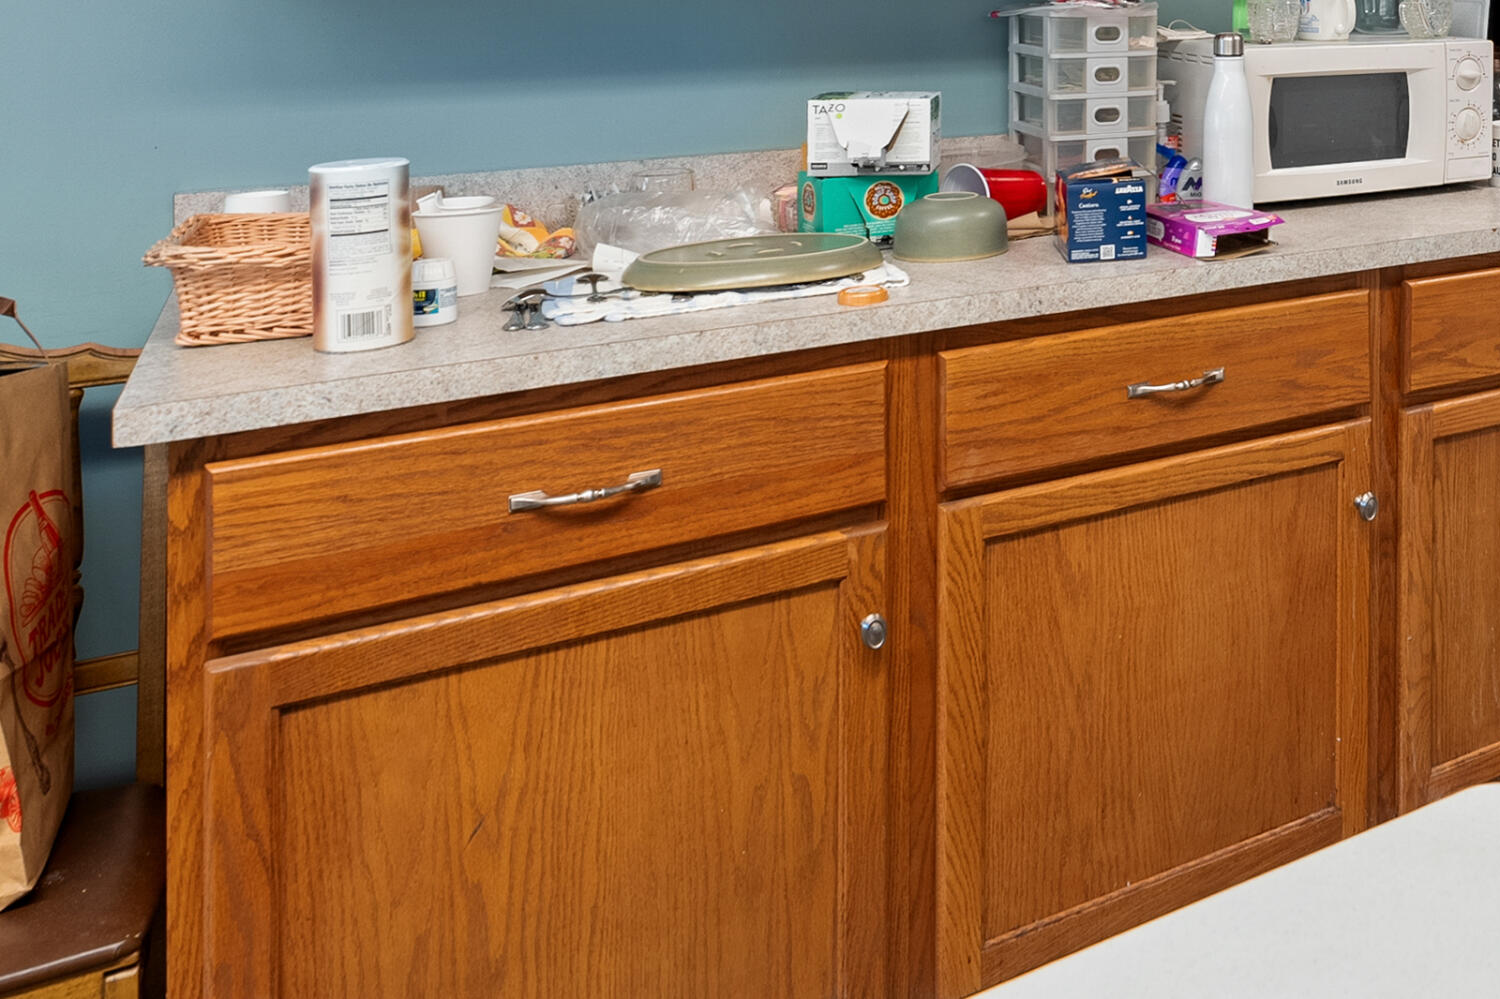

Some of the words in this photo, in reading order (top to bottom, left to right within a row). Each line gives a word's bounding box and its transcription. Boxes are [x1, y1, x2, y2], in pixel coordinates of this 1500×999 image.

[812, 103, 845, 115] TAZO
[1336, 178, 1362, 186] SAMSUNG
[1115, 184, 1144, 195] LAVAZZA
